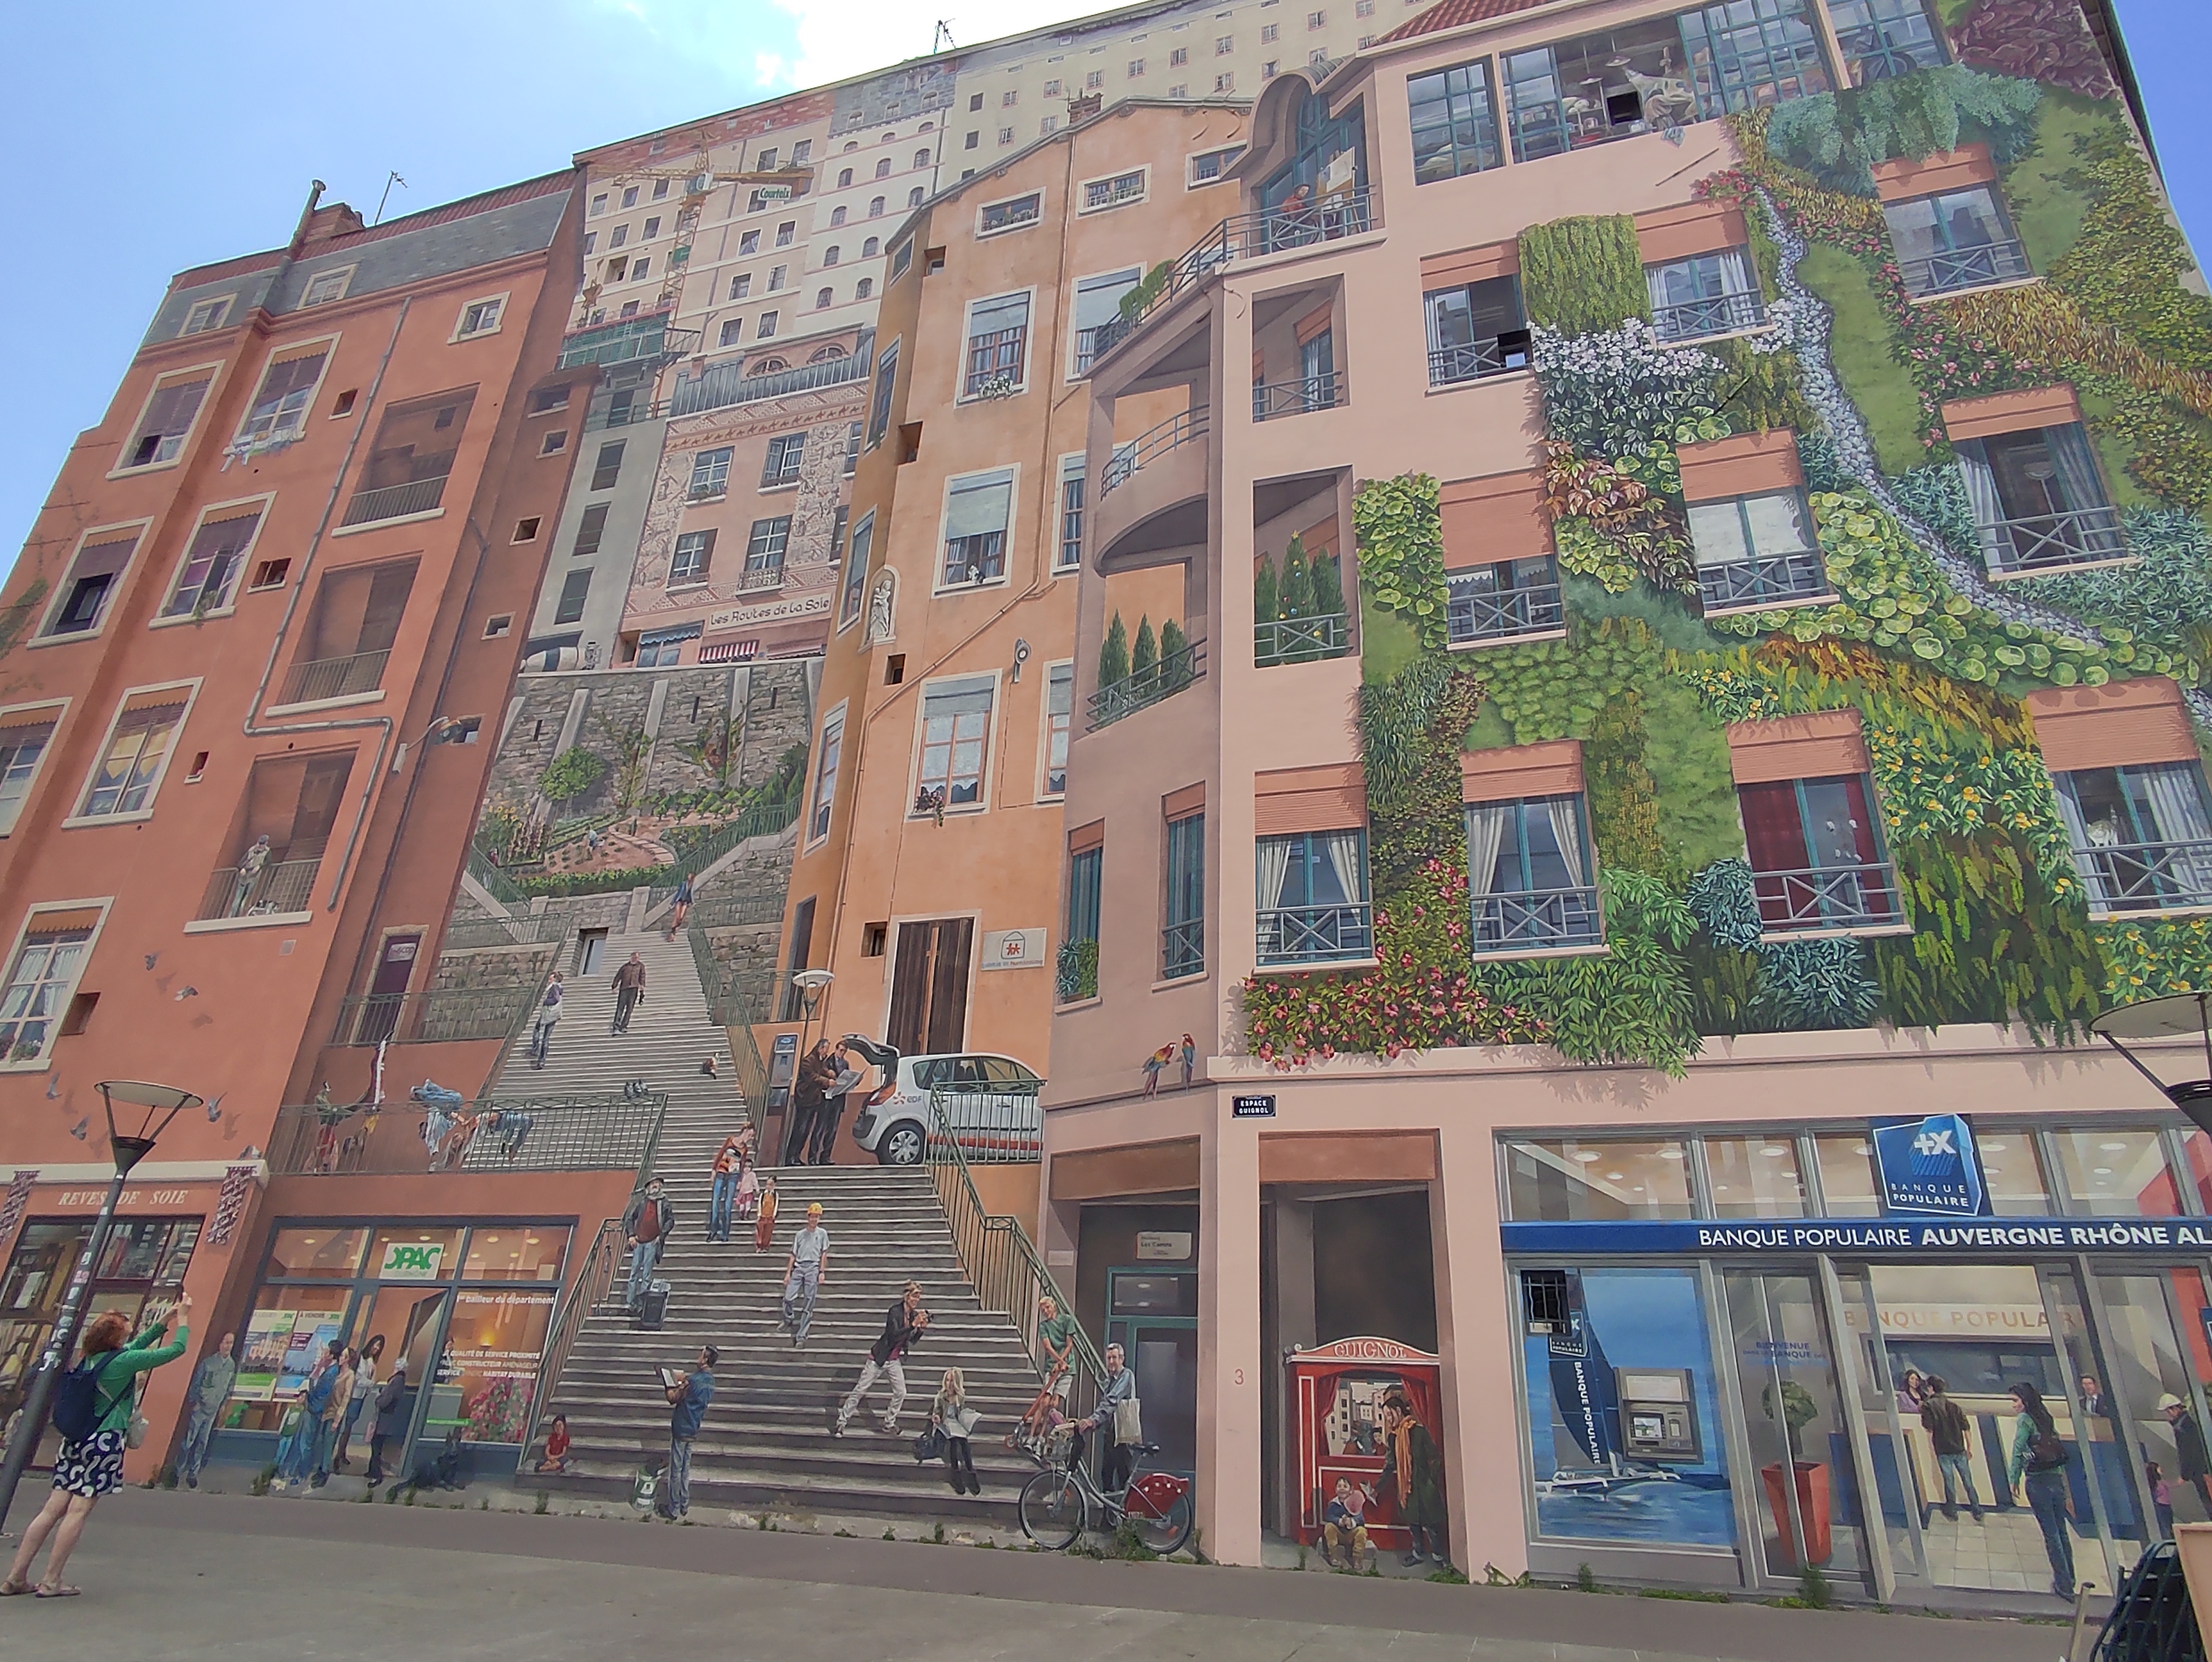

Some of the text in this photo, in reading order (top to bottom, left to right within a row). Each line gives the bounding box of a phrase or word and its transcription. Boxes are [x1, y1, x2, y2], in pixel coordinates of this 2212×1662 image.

[731, 608, 771, 622] Routes
[774, 604, 787, 615] de
[805, 598, 830, 611] Soie
[1891, 1183, 1967, 1194] BANQUE
[117, 1191, 140, 1205] DE
[150, 1190, 190, 1205] SOIE
[1893, 1193, 1970, 1207] POPULAIRE
[1699, 1229, 1790, 1249] BANQUE
[1794, 1229, 1913, 1246] POPULAIRE
[1921, 1228, 2065, 1246] AUVERGNE
[2071, 1222, 2170, 1246] RHÔNE
[495, 1296, 506, 1304] du
[506, 1295, 554, 1305] département
[1844, 1311, 1942, 1329] BNQUE
[1335, 1341, 1407, 1358] GUIGNOL
[1235, 1369, 1244, 1385] 3
[1574, 1361, 1601, 1465] BANQUE POPULAIRE
